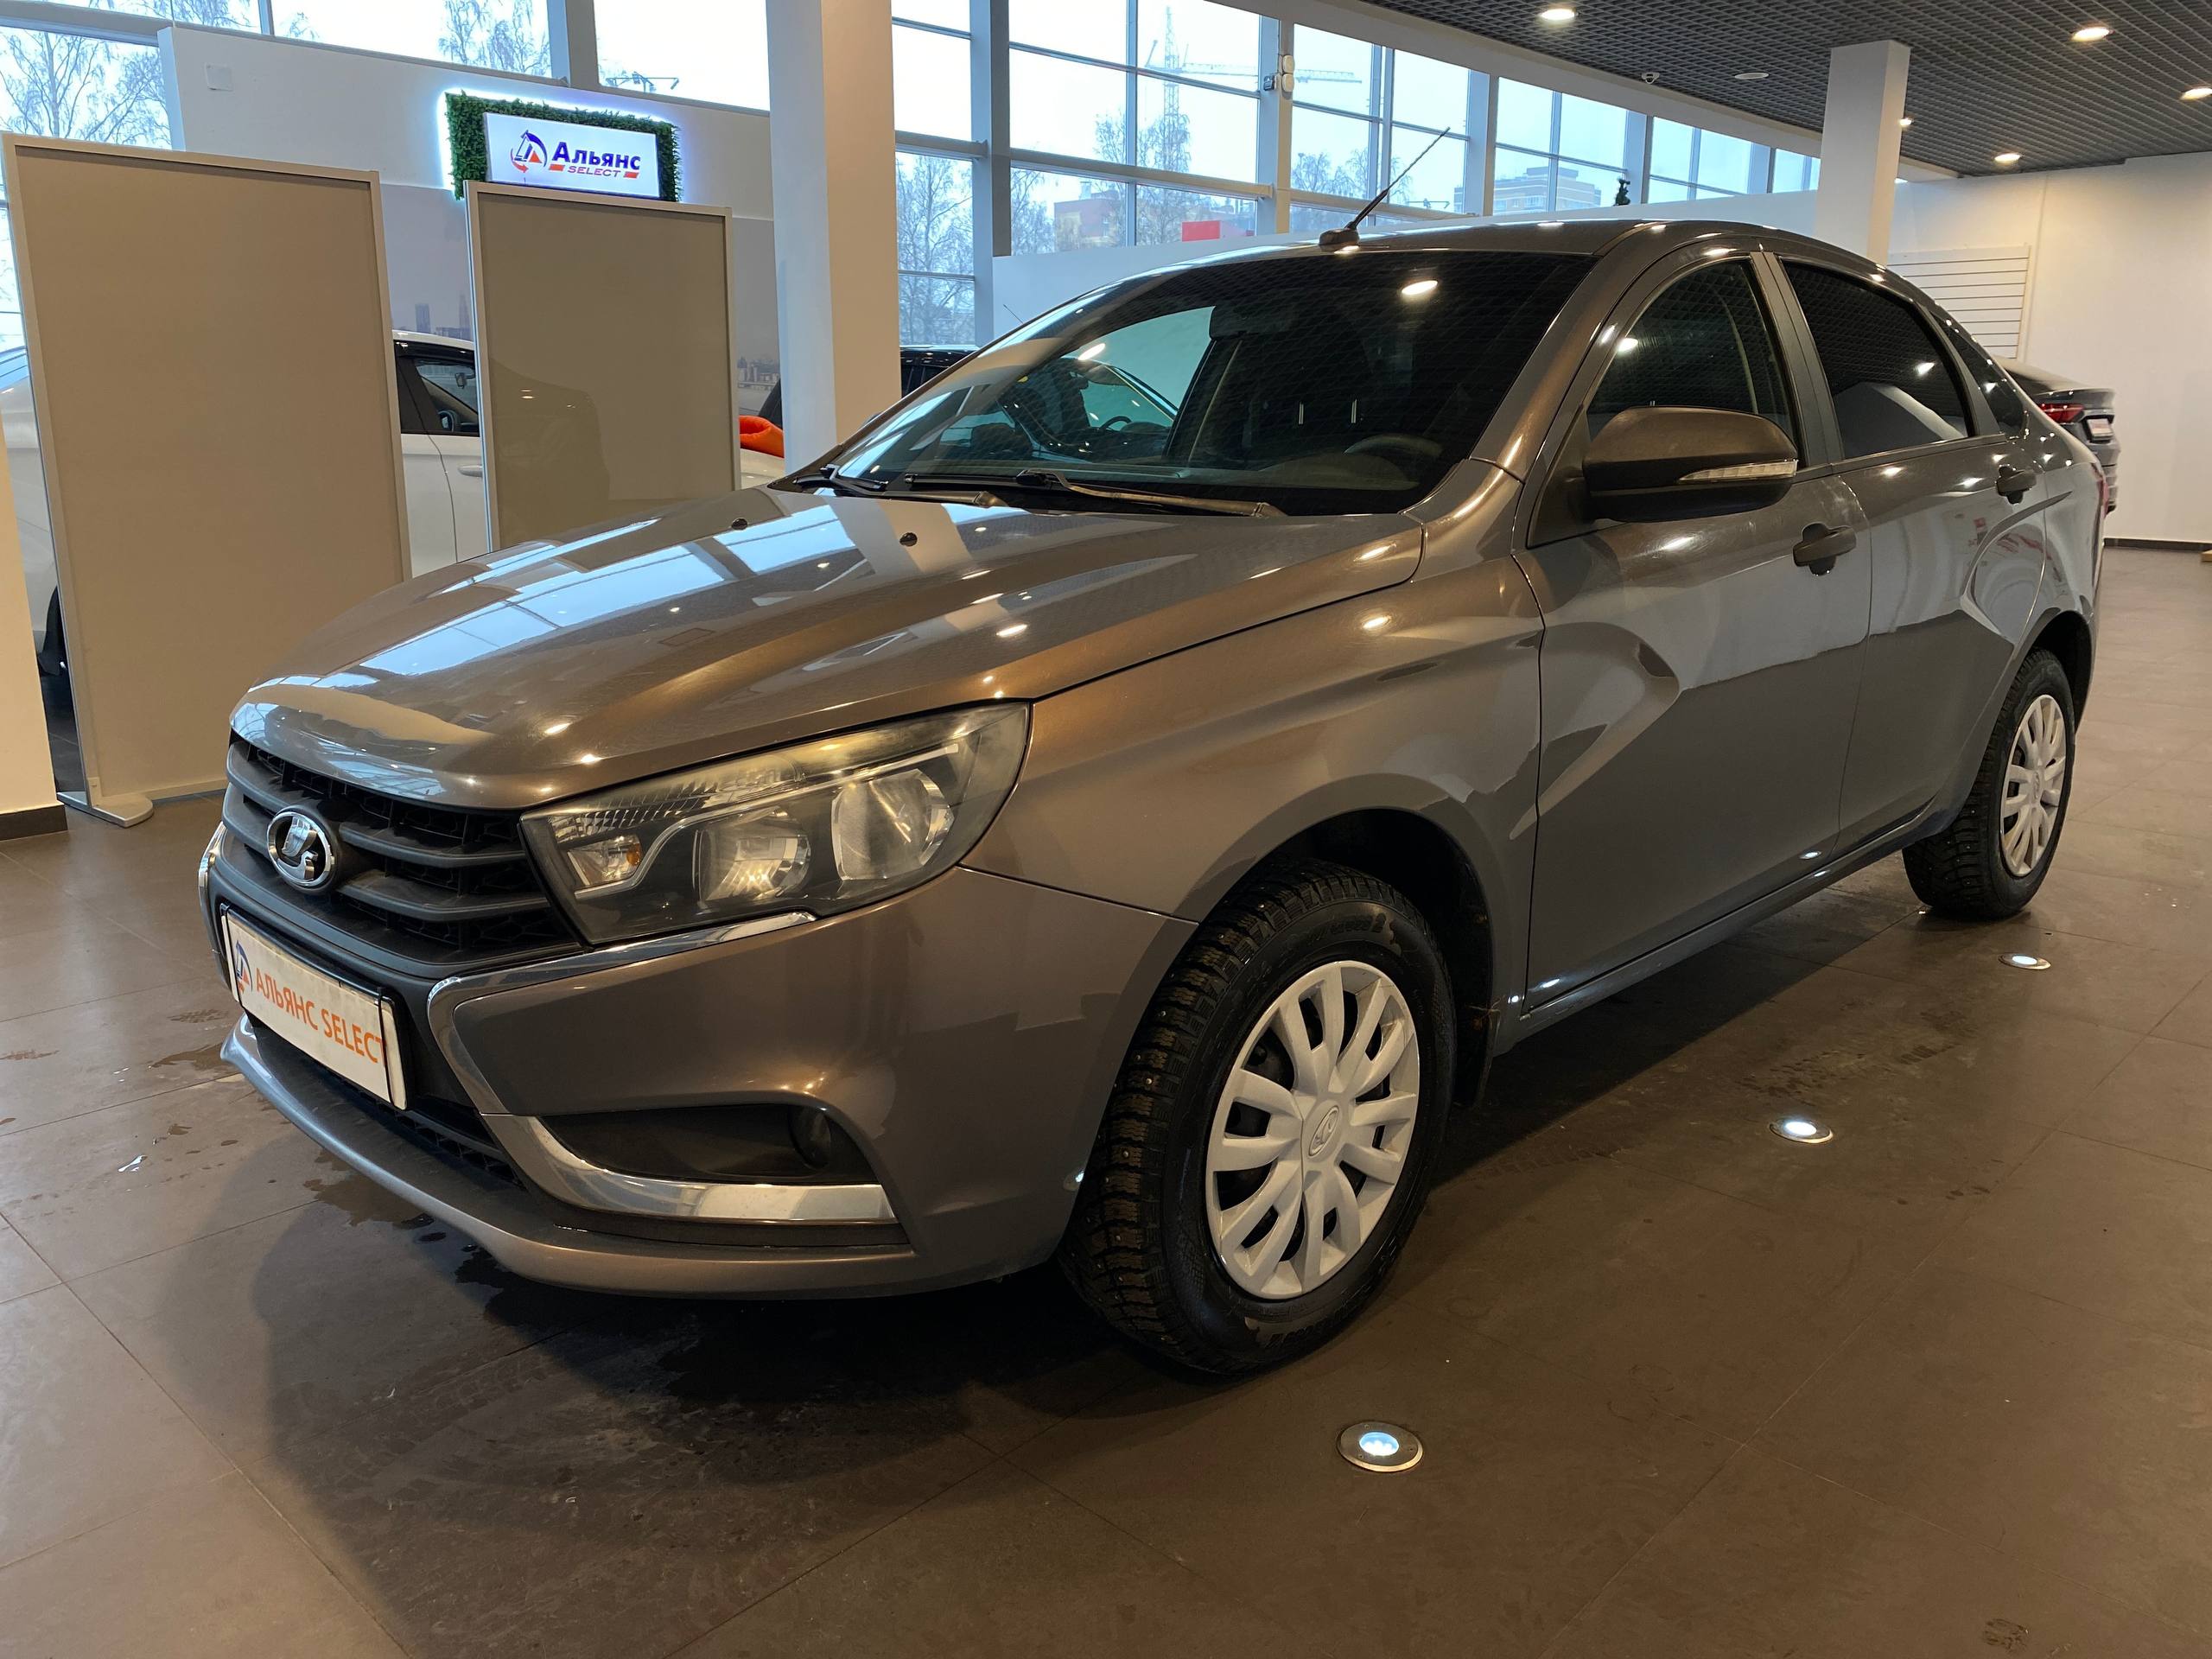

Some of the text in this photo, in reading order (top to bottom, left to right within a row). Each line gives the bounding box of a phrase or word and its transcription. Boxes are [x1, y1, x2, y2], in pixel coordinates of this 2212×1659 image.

[551, 141, 641, 169] Альянс
[567, 165, 621, 178] SELECT
[256, 967, 319, 1031] АЛЬЯНС
